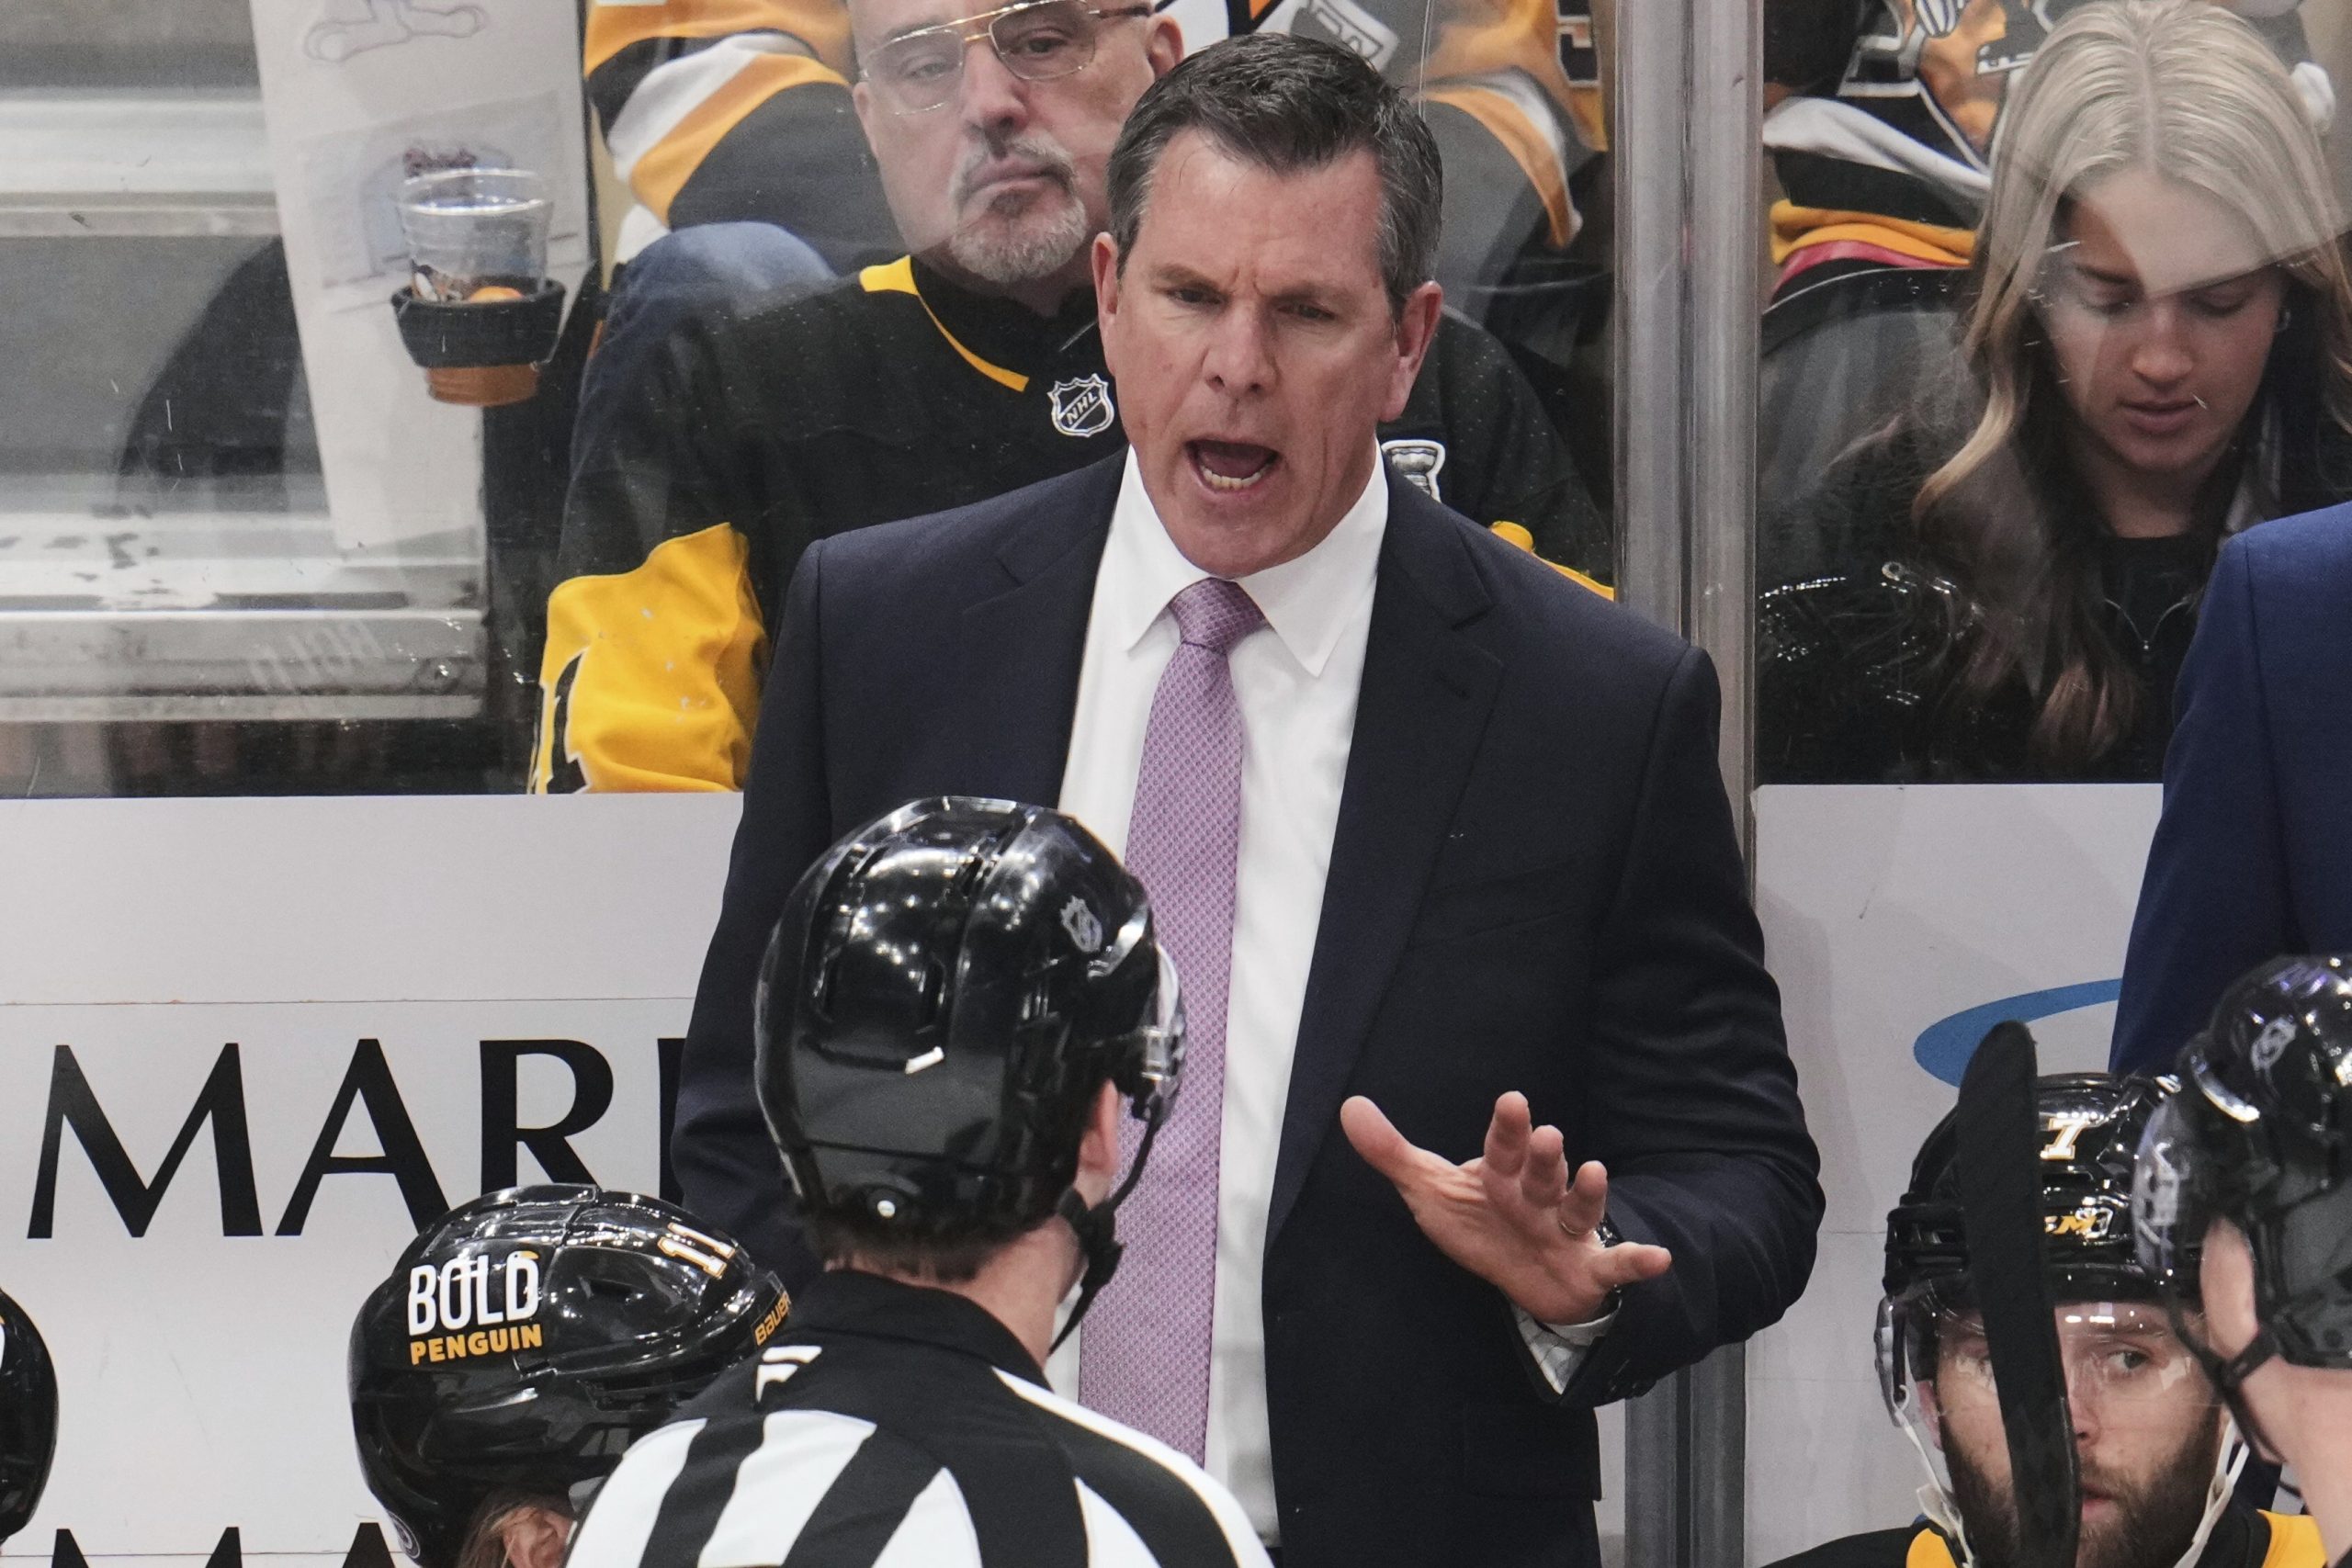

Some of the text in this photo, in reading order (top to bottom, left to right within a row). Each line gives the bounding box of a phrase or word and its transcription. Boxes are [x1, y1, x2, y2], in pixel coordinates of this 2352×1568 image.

[1067, 391, 1098, 425] NHL
[27, 1038, 686, 1239] MAR
[657, 1222, 735, 1278] 11
[407, 1250, 539, 1337] BOLD
[410, 1324, 543, 1366] PENGUIN
